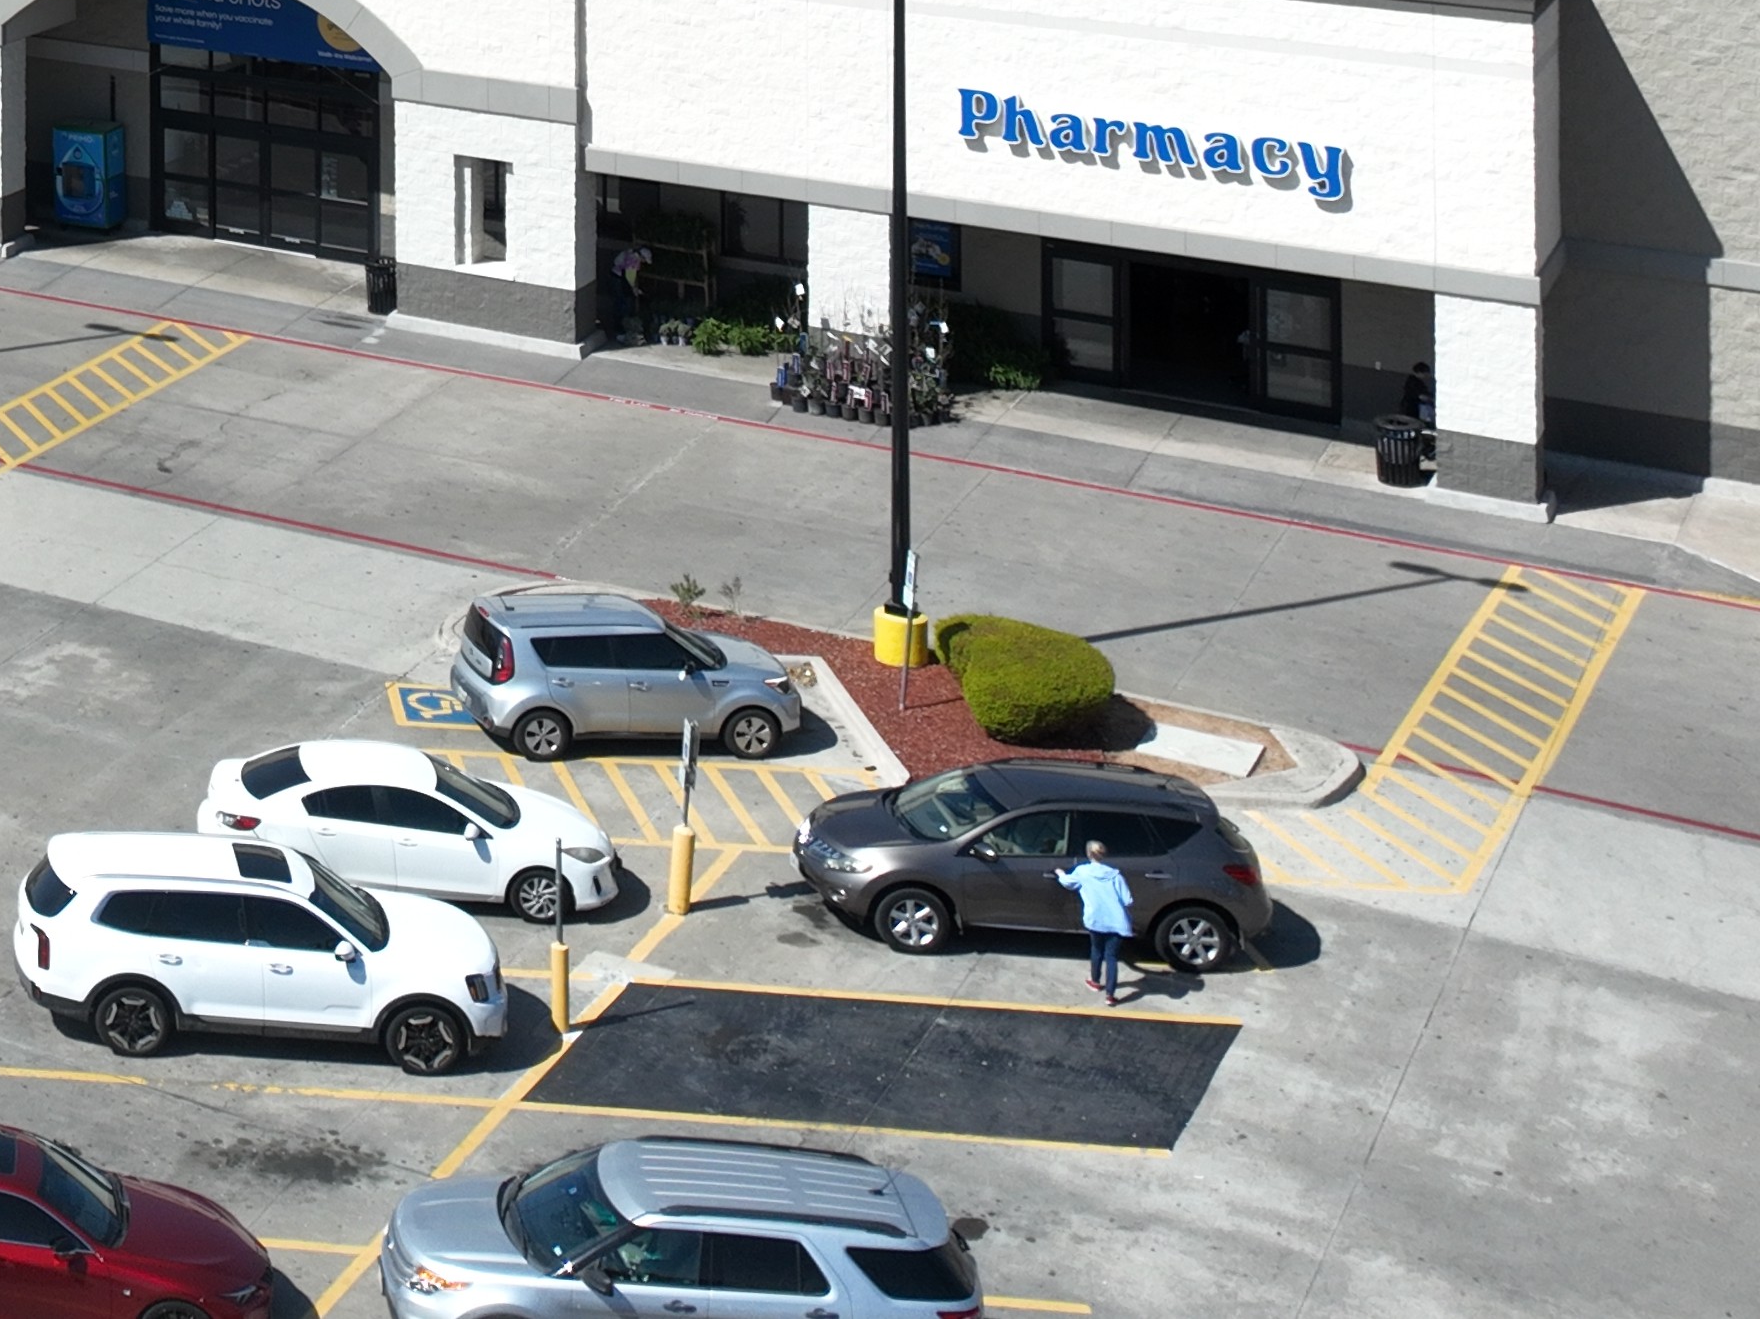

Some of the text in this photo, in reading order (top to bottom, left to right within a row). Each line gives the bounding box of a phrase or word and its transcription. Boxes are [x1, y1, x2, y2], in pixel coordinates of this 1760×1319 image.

[154, 4, 174, 13] Save
[174, 6, 195, 17] more
[195, 9, 218, 20] when
[233, 15, 274, 26] vaccinate
[957, 88, 1345, 201] Pharmacy
